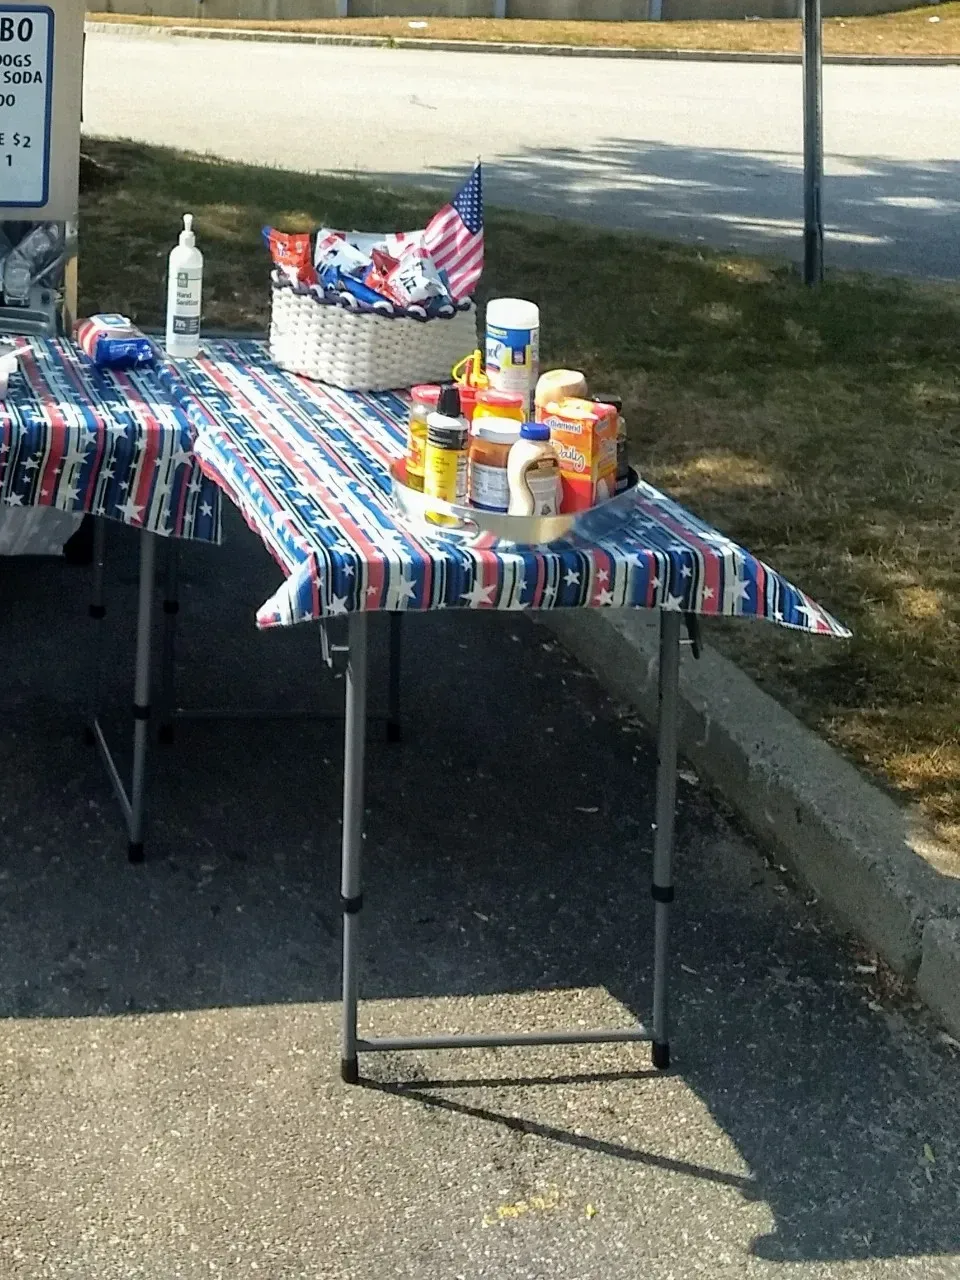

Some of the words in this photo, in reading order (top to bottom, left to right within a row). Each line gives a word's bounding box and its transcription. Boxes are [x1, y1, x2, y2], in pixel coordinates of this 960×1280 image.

[3, 71, 43, 84] SODA
[13, 133, 32, 148] $2
[176, 291, 192, 299] Hand
